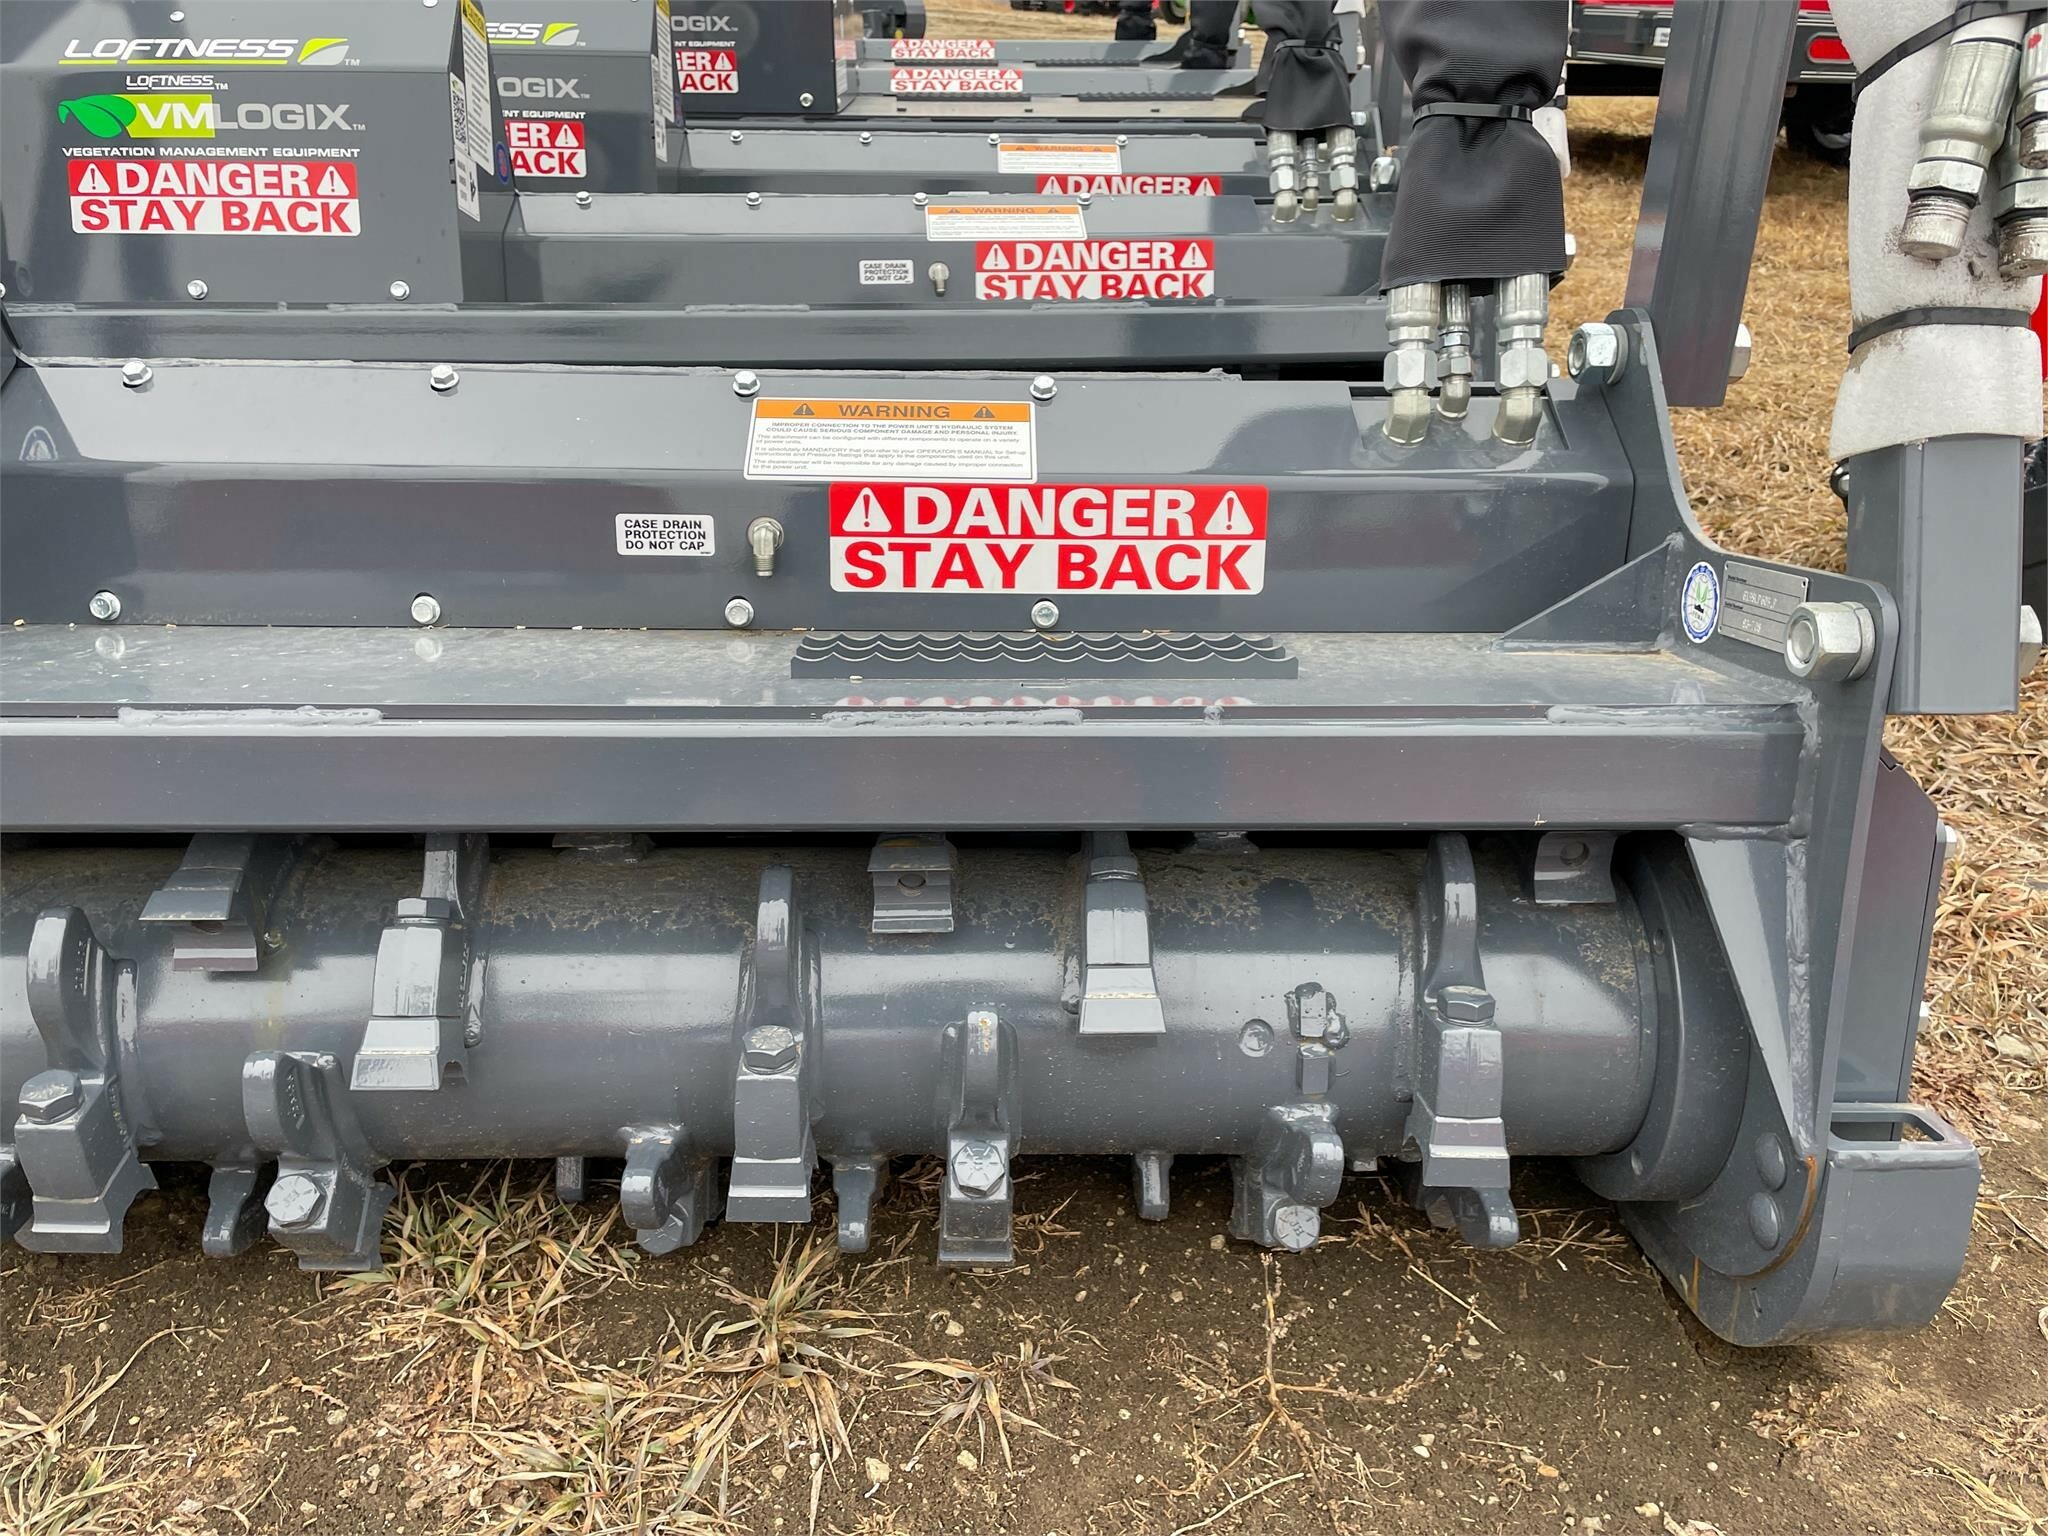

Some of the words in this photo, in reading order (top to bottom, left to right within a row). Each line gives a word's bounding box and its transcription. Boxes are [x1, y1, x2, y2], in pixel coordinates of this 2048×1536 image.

[64, 39, 299, 60] LOFTNESS
[908, 40, 977, 48] DANGER
[895, 49, 938, 58] STAY
[945, 49, 990, 58] BACK
[126, 75, 214, 88] LOFTNESS
[681, 73, 733, 91] ACK
[913, 69, 1001, 80] DANGER
[895, 80, 951, 91] STAY
[960, 80, 1018, 91] BACK
[137, 103, 352, 130] VMLOGIX
[522, 110, 586, 119] EQUIPMENT
[505, 122, 550, 148] ER
[62, 147, 155, 157] VEGETATION
[160, 147, 268, 157] MANAGEMENT
[273, 147, 360, 158] EQUIPMENT
[115, 162, 312, 196] DANGER
[1067, 176, 1192, 196] DANGER
[81, 199, 205, 231] STAY
[222, 200, 353, 233] BACK
[1015, 241, 1176, 270] DANGER
[984, 273, 1087, 300] STAY
[1100, 273, 1206, 300] BACK
[838, 404, 950, 418] WARNING
[903, 487, 1196, 537] DANGER
[624, 519, 658, 529] CASE
[662, 519, 702, 529] DRAIN
[625, 529, 706, 540] PROTECTION
[625, 540, 644, 550] DO
[649, 540, 675, 550] NOT
[679, 541, 705, 551] CAP
[843, 541, 1031, 590] STAY
[1057, 543, 1252, 591] BACK
